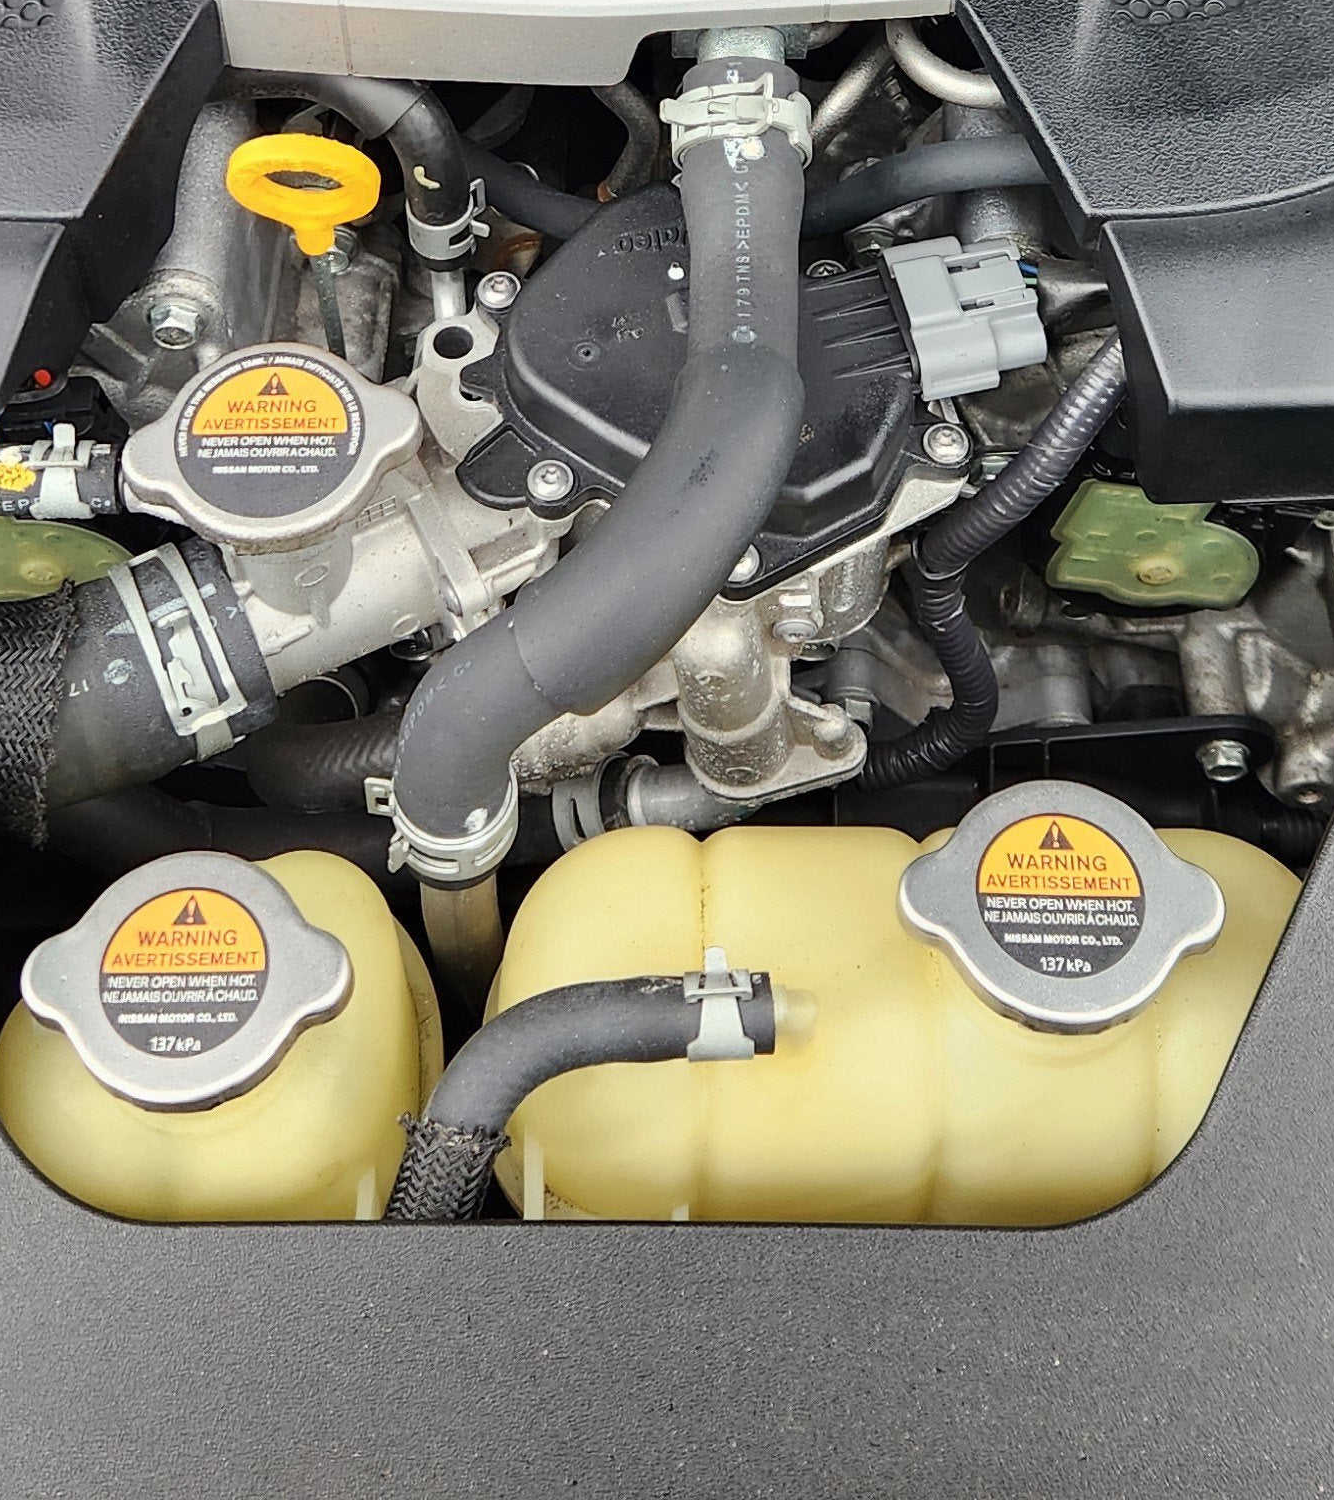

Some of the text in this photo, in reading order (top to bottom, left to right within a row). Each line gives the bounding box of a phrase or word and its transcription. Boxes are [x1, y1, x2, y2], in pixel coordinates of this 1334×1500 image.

[228, 400, 317, 413] WARNING
[203, 417, 339, 430] AVERTISSEMENT
[201, 436, 335, 447] NEVER OPEN WHEN HOT.
[212, 448, 249, 458] JAMAIS
[212, 466, 247, 474] NISSAN
[248, 466, 281, 474] MOTOR
[1006, 853, 1107, 871] WARNING
[986, 874, 1132, 891] AVERTISSEMENT
[986, 896, 1135, 912] NEVER OPEN WHEN HOT.
[984, 910, 1000, 923] NE
[1000, 911, 1041, 924] JAMAIS
[1042, 912, 1086, 925] OUVRIR
[1095, 914, 1140, 926] CHAUD.
[138, 930, 238, 946] WARNING
[1004, 933, 1041, 944] NISSAN
[1043, 934, 1080, 945] MOTOR
[1102, 935, 1123, 946] LTD.
[112, 951, 258, 967] AVERTISSEMENT
[108, 975, 257, 988] NEVER OPEN WHEN HOT.
[120, 990, 161, 1003] JAMAIS
[162, 989, 204, 1003] OUVRIR
[215, 988, 258, 1002] CHAUD.
[118, 1013, 157, 1024] NISSAN
[158, 1013, 195, 1024] MOTOR
